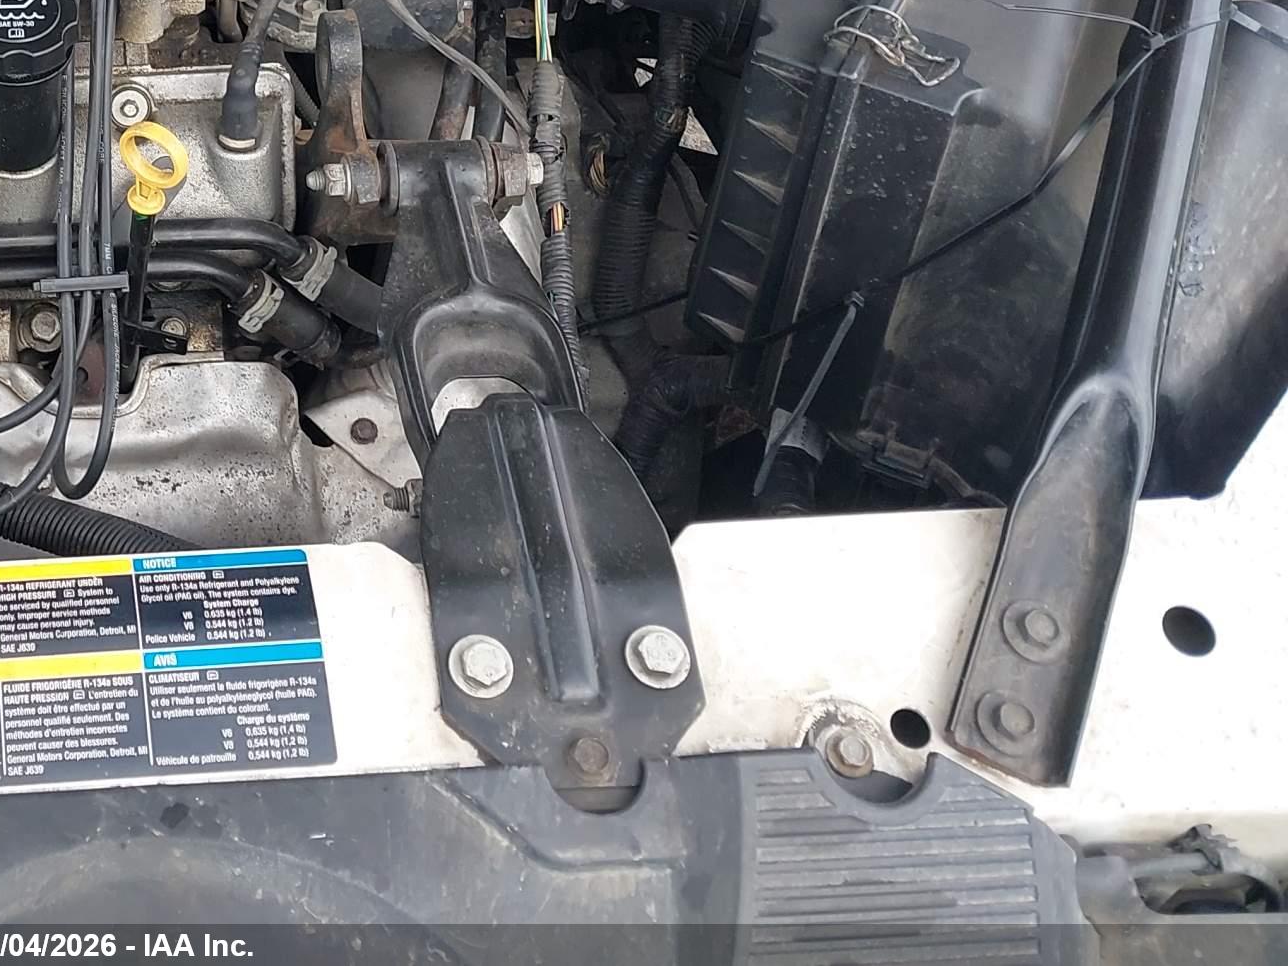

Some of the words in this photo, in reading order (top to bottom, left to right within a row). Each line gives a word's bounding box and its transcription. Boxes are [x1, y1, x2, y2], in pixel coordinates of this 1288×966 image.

[142, 558, 176, 568] NOTICE
[153, 572, 206, 582] CONDITIONING
[25, 579, 75, 590] REFRIGERANT
[77, 577, 102, 586] UNDER
[155, 584, 170, 593] only
[171, 582, 197, 590] R-134a
[17, 590, 56, 600] PRESSURE
[77, 587, 104, 597] System
[141, 593, 162, 603] Glycol
[174, 592, 191, 600] (PAG
[207, 590, 221, 598] The
[223, 589, 248, 598] system
[250, 587, 280, 595] contains
[9, 601, 39, 610] serviced
[41, 601, 50, 609] by
[203, 599, 231, 609] System
[232, 597, 258, 607] Charge
[17, 611, 50, 620] Improper
[51, 609, 77, 617] service
[225, 608, 236, 618] kg
[236, 607, 251, 617] (1.4
[0, 624, 15, 632] may
[40, 620, 71, 628] personal
[227, 619, 237, 628] kg
[238, 618, 252, 627] (1.2
[29, 630, 53, 639] Motors
[126, 625, 136, 633] MI
[145, 633, 167, 643] Police
[168, 632, 195, 642] Vehicle
[228, 629, 238, 640] kg
[239, 628, 254, 639] (1.2
[0, 644, 15, 653] SAE
[153, 653, 177, 666] AVIS
[148, 671, 199, 683] CLIMATISEUR
[289, 676, 316, 686] R-134a
[3, 682, 29, 693] FLUIDE
[83, 677, 111, 687] R-134a
[112, 676, 133, 686] SOUS
[4, 694, 28, 704] HAUTE
[30, 692, 69, 703] PRESSION
[128, 688, 138, 696] du
[150, 698, 158, 706] et
[159, 697, 169, 706] de
[37, 705, 51, 714] doit
[101, 702, 114, 711] par
[151, 709, 161, 718] Le
[195, 705, 225, 715] contient
[226, 704, 237, 714] du
[5, 718, 41, 728] personnel
[114, 711, 129, 721] Des
[236, 714, 264, 726] Charge
[265, 714, 276, 723] du
[268, 725, 278, 736] kg
[38, 740, 63, 749] causer
[64, 738, 78, 748] des
[269, 737, 280, 748] kg
[7, 753, 35, 763] General
[36, 751, 62, 761] Motors
[138, 745, 147, 754] MI
[189, 754, 199, 763] de
[271, 749, 281, 760] kg
[8, 765, 22, 775] SAE
